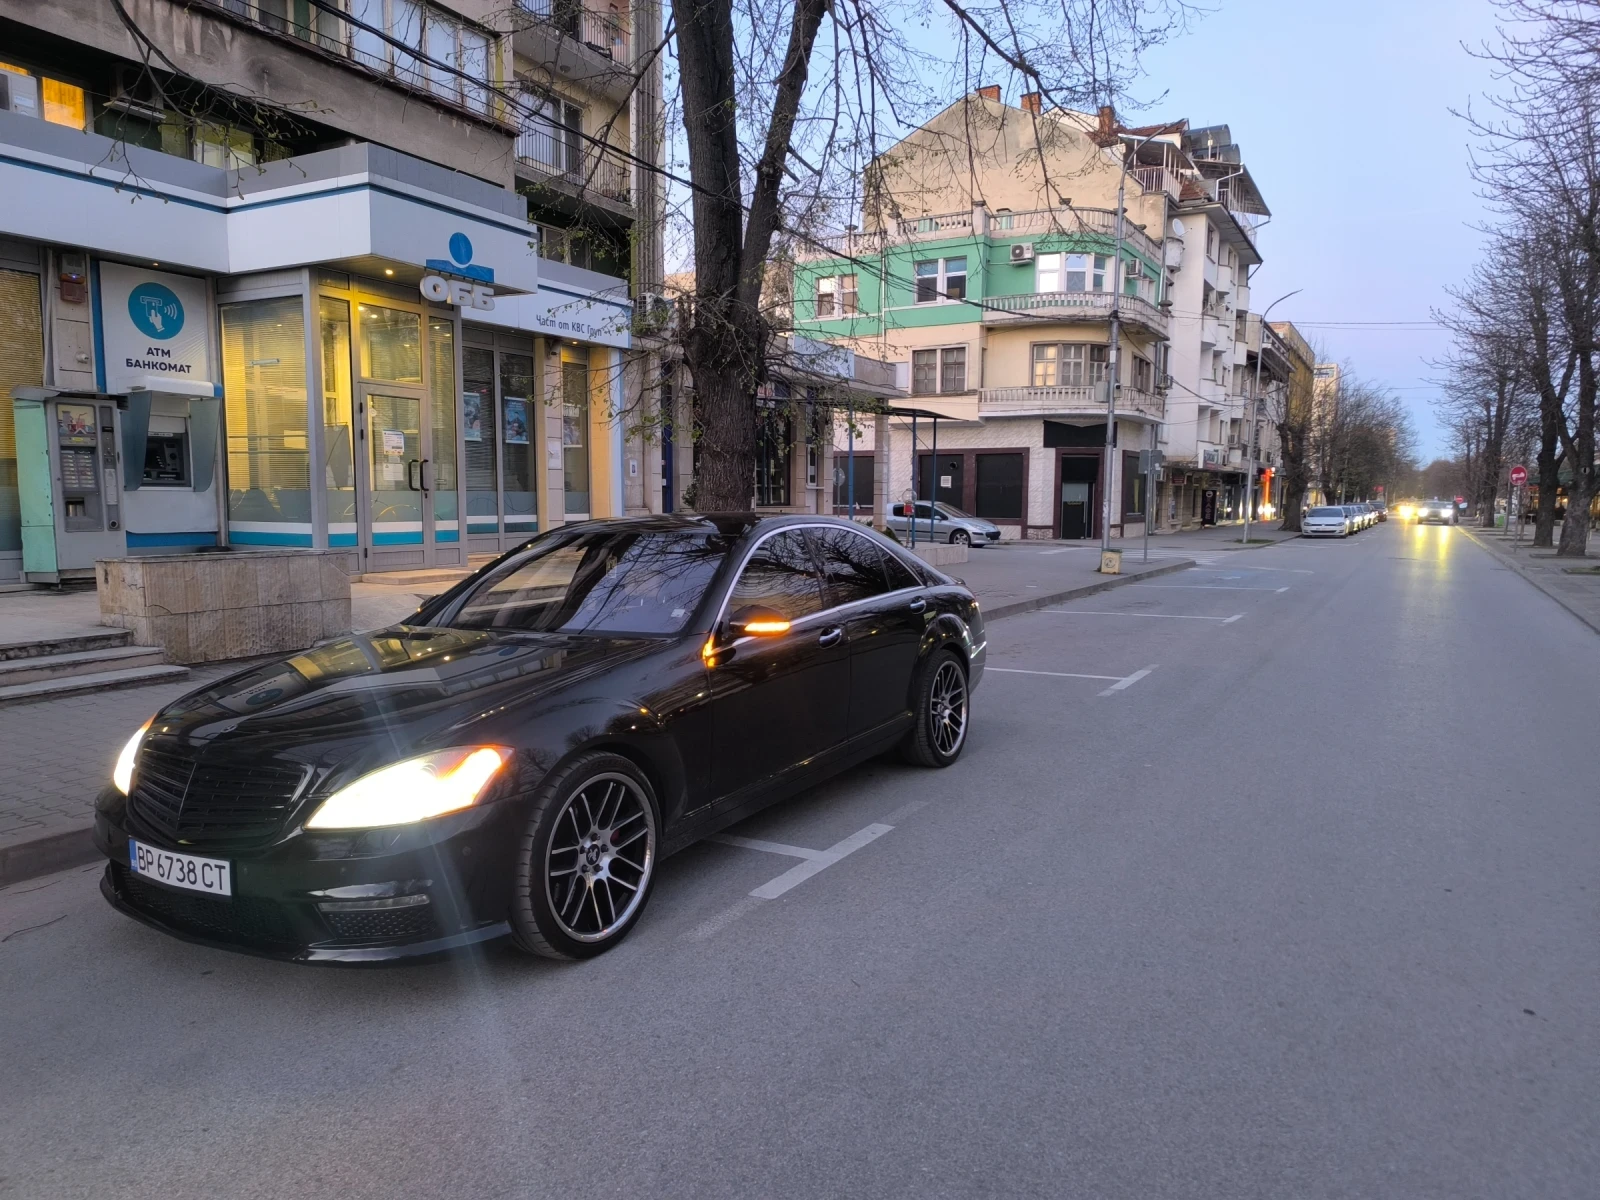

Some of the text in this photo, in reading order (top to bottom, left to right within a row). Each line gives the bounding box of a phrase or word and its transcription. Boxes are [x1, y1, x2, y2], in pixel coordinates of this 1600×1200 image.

[420, 275, 495, 311] ОББ
[536, 314, 556, 328] Част
[558, 321, 570, 331] от
[571, 321, 585, 334] КВС
[125, 357, 192, 374] БАНКОМАТ
[137, 845, 226, 891] BP 6738 CT
